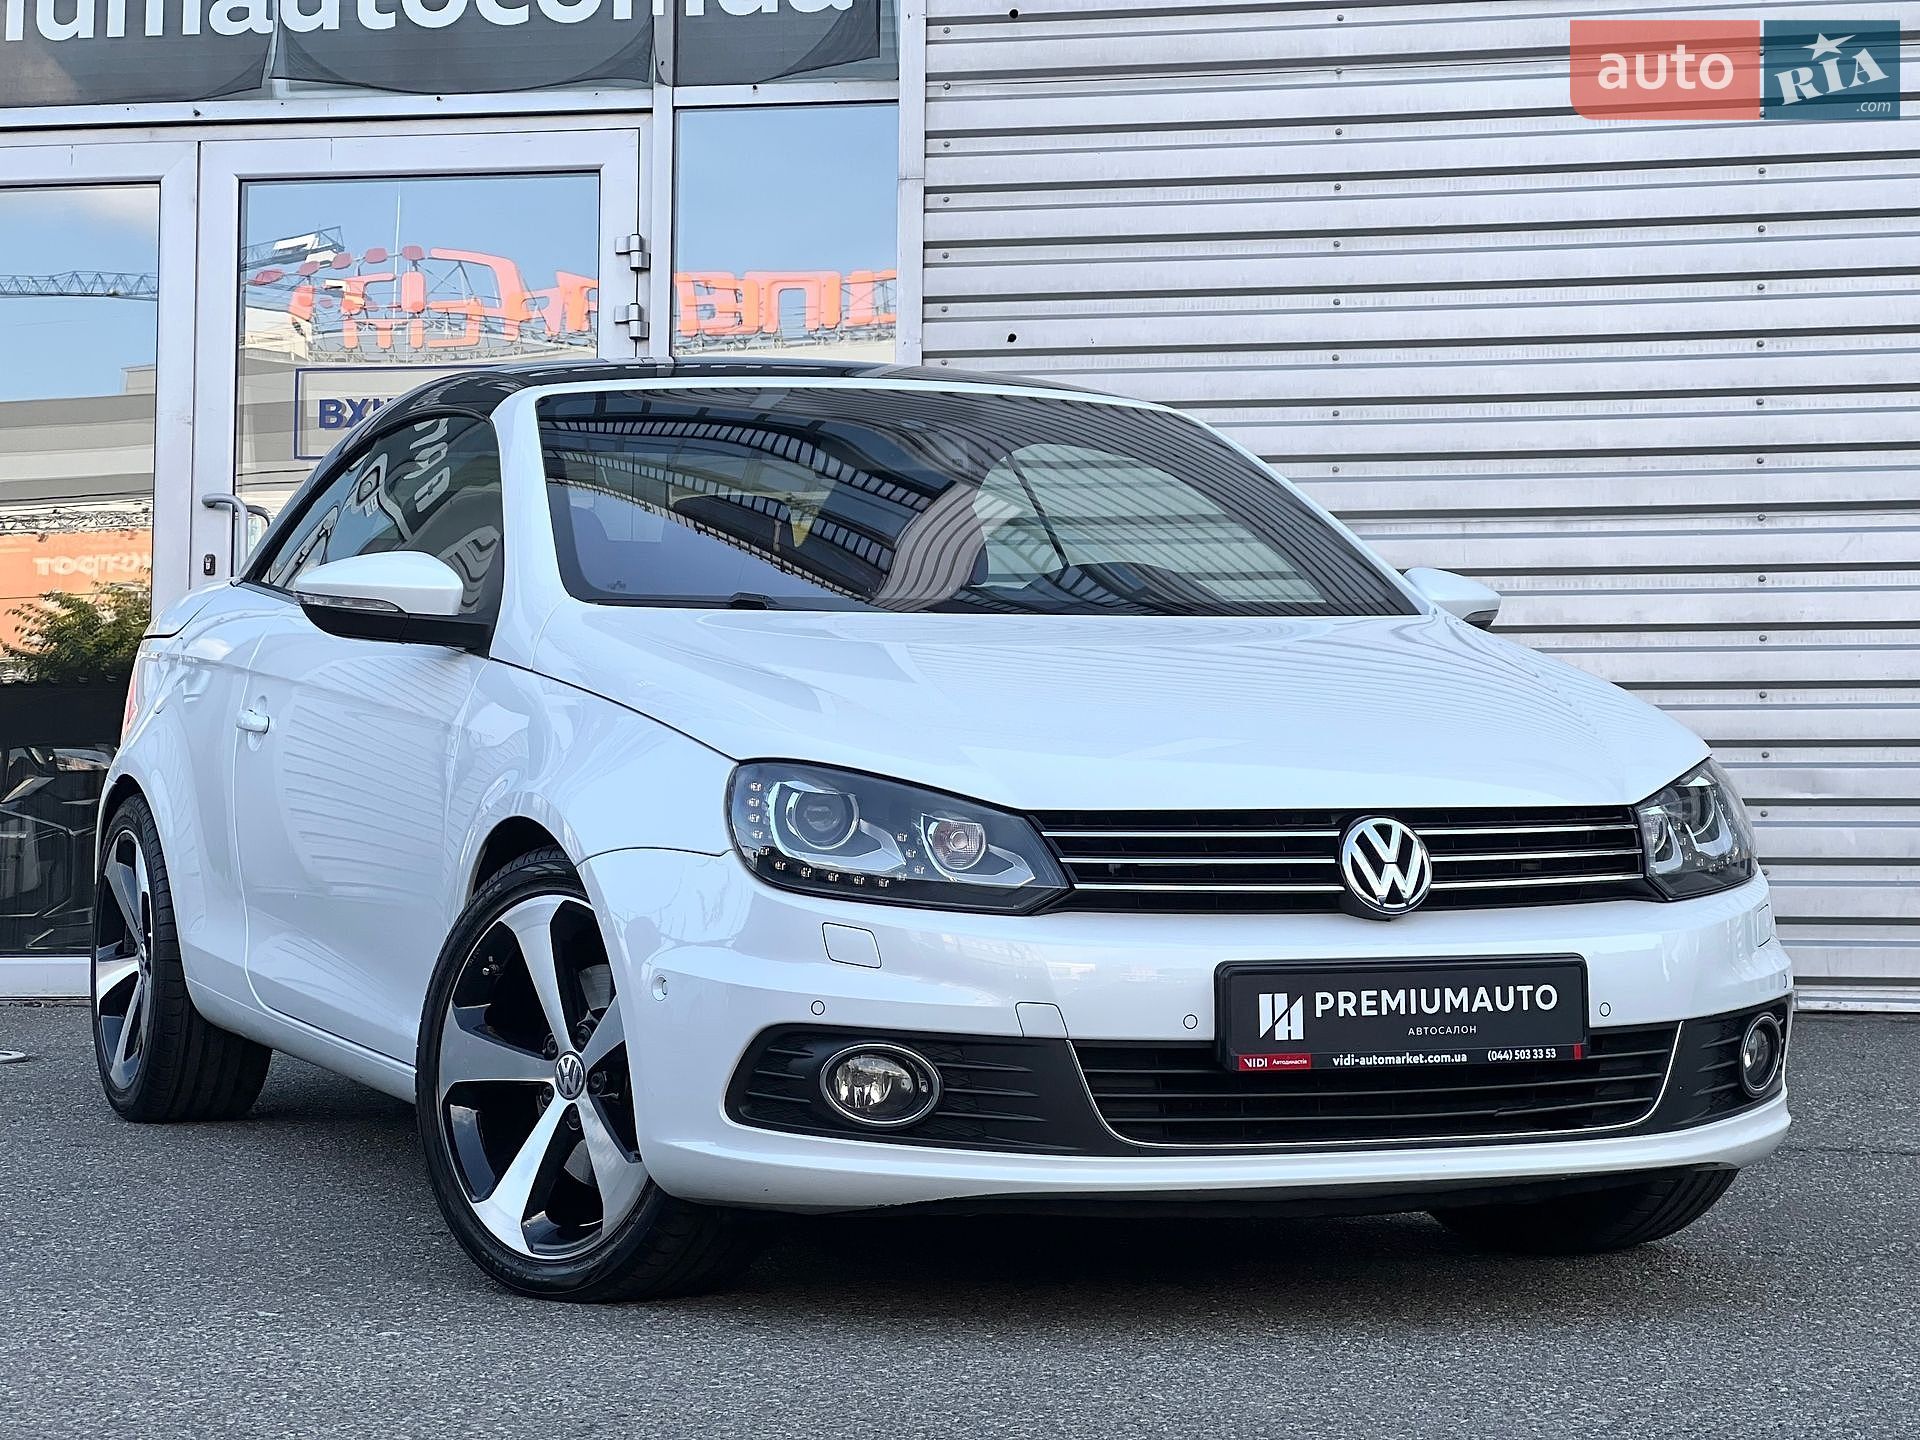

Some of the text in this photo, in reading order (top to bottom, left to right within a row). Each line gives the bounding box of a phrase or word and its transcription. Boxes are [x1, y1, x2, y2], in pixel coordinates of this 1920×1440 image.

[319, 398, 394, 429] ВХ
[1314, 984, 1558, 1018] PREMIUMAUTO
[1408, 1025, 1477, 1036] АВТОСАЛОН
[1332, 1052, 1468, 1067] vidi-automarket.com.ua
[1487, 1048, 1557, 1062] (044) 503 33 53
[1243, 1057, 1268, 1068] VIDI
